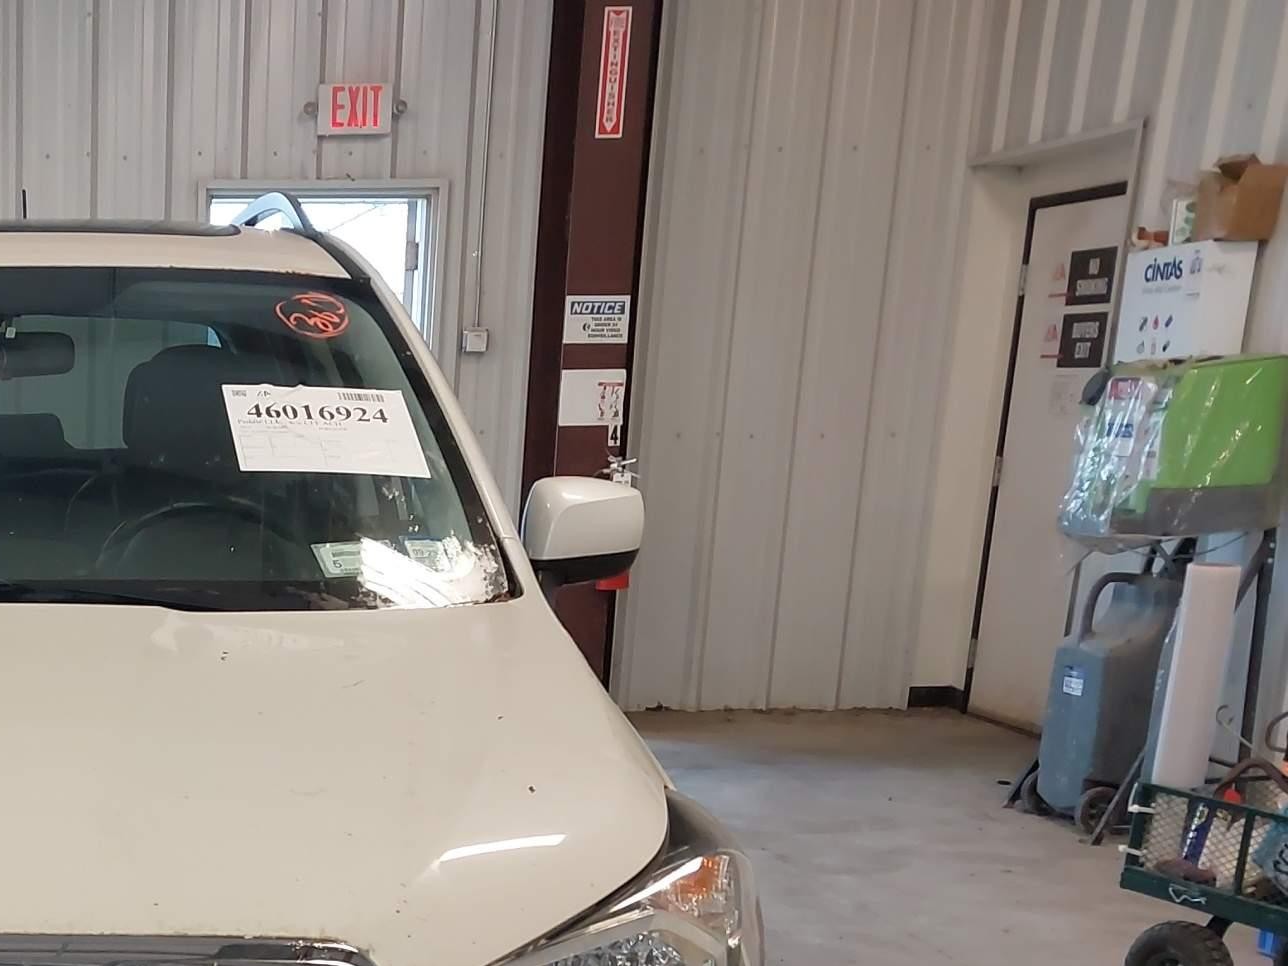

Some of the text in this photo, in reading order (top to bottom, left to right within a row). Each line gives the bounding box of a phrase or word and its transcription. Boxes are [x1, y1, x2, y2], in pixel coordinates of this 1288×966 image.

[331, 85, 383, 128] EXIT
[1144, 256, 1183, 283] CINTAS
[571, 302, 624, 314] NOTICE
[246, 402, 389, 424] 46016924
[610, 424, 619, 445] 4
[332, 559, 343, 569] 5
